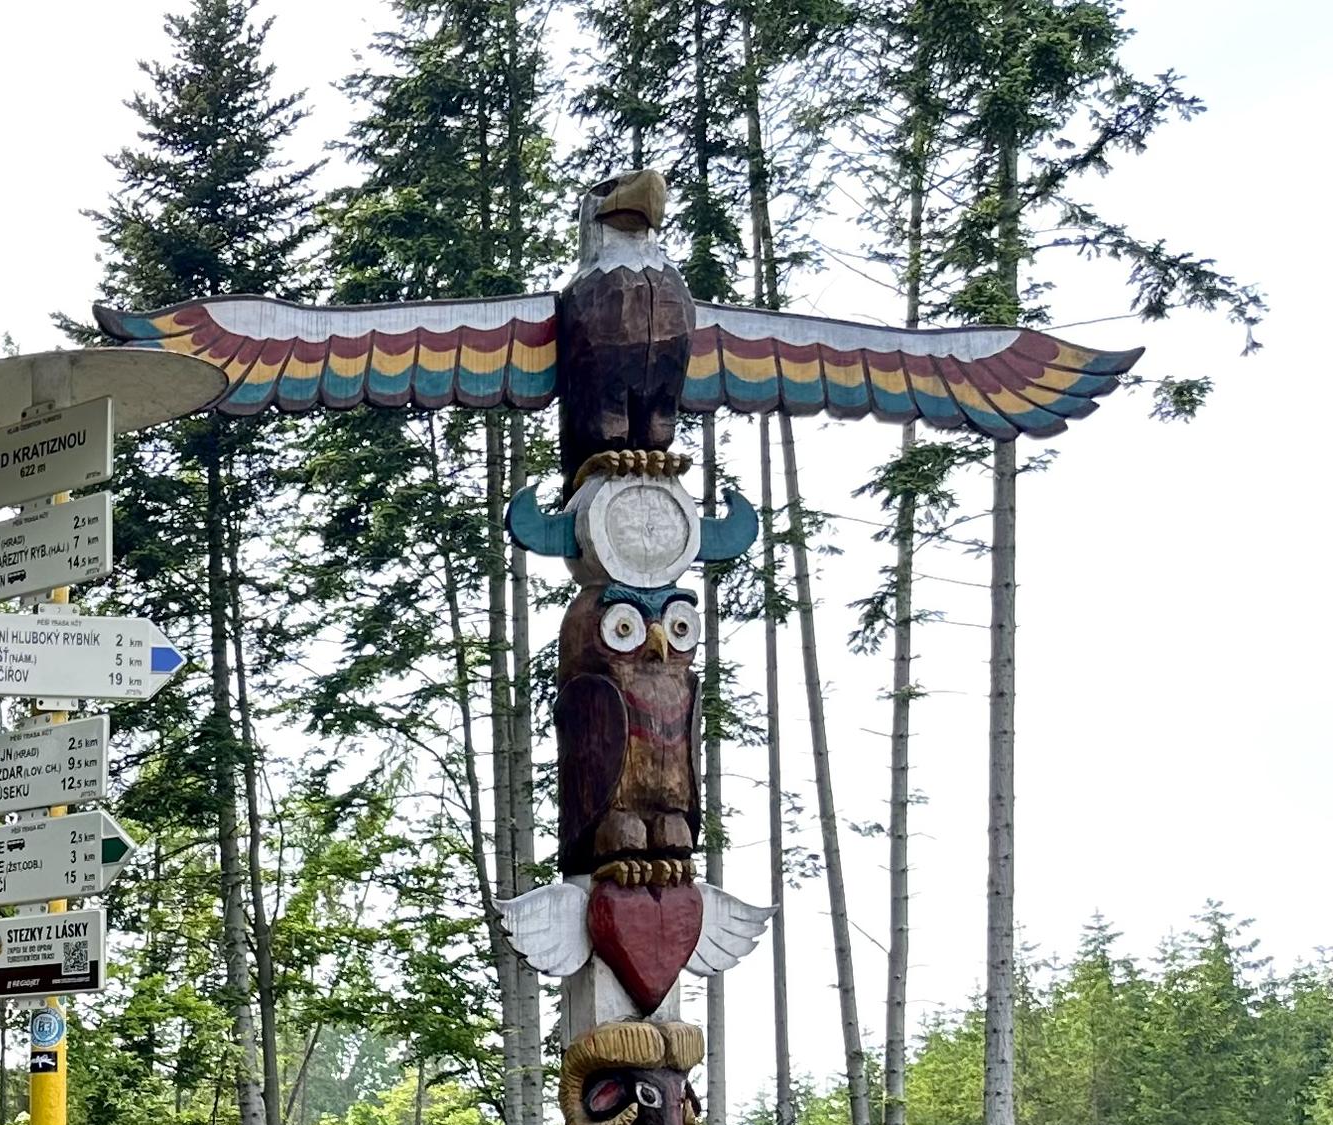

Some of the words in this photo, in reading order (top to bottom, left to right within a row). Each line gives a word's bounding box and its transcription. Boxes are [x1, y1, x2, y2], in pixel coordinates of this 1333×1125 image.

[13, 430, 86, 464] KRATIZNOU
[20, 464, 35, 478] 622
[37, 463, 46, 473] m
[88, 516, 99, 525] km
[74, 536, 79, 549] 7
[88, 536, 99, 545] km
[88, 557, 99, 566] km
[12, 629, 60, 645] HLUBOKÝ
[63, 629, 101, 646] RYBNÍK
[116, 634, 123, 646] 2
[129, 637, 143, 647] km
[115, 653, 123, 666] 5
[129, 657, 142, 666] km
[109, 673, 123, 685] 19
[129, 677, 142, 686] km
[85, 738, 98, 747] km
[84, 758, 97, 767] km
[84, 779, 97, 787] km
[84, 833, 95, 842] km
[71, 850, 76, 863] 3
[84, 852, 95, 861] km
[64, 871, 76, 884] 15
[84, 872, 95, 880] km
[7, 926, 43, 943] STEZKY
[46, 926, 52, 940] Z
[55, 920, 89, 939] LÁSKY
